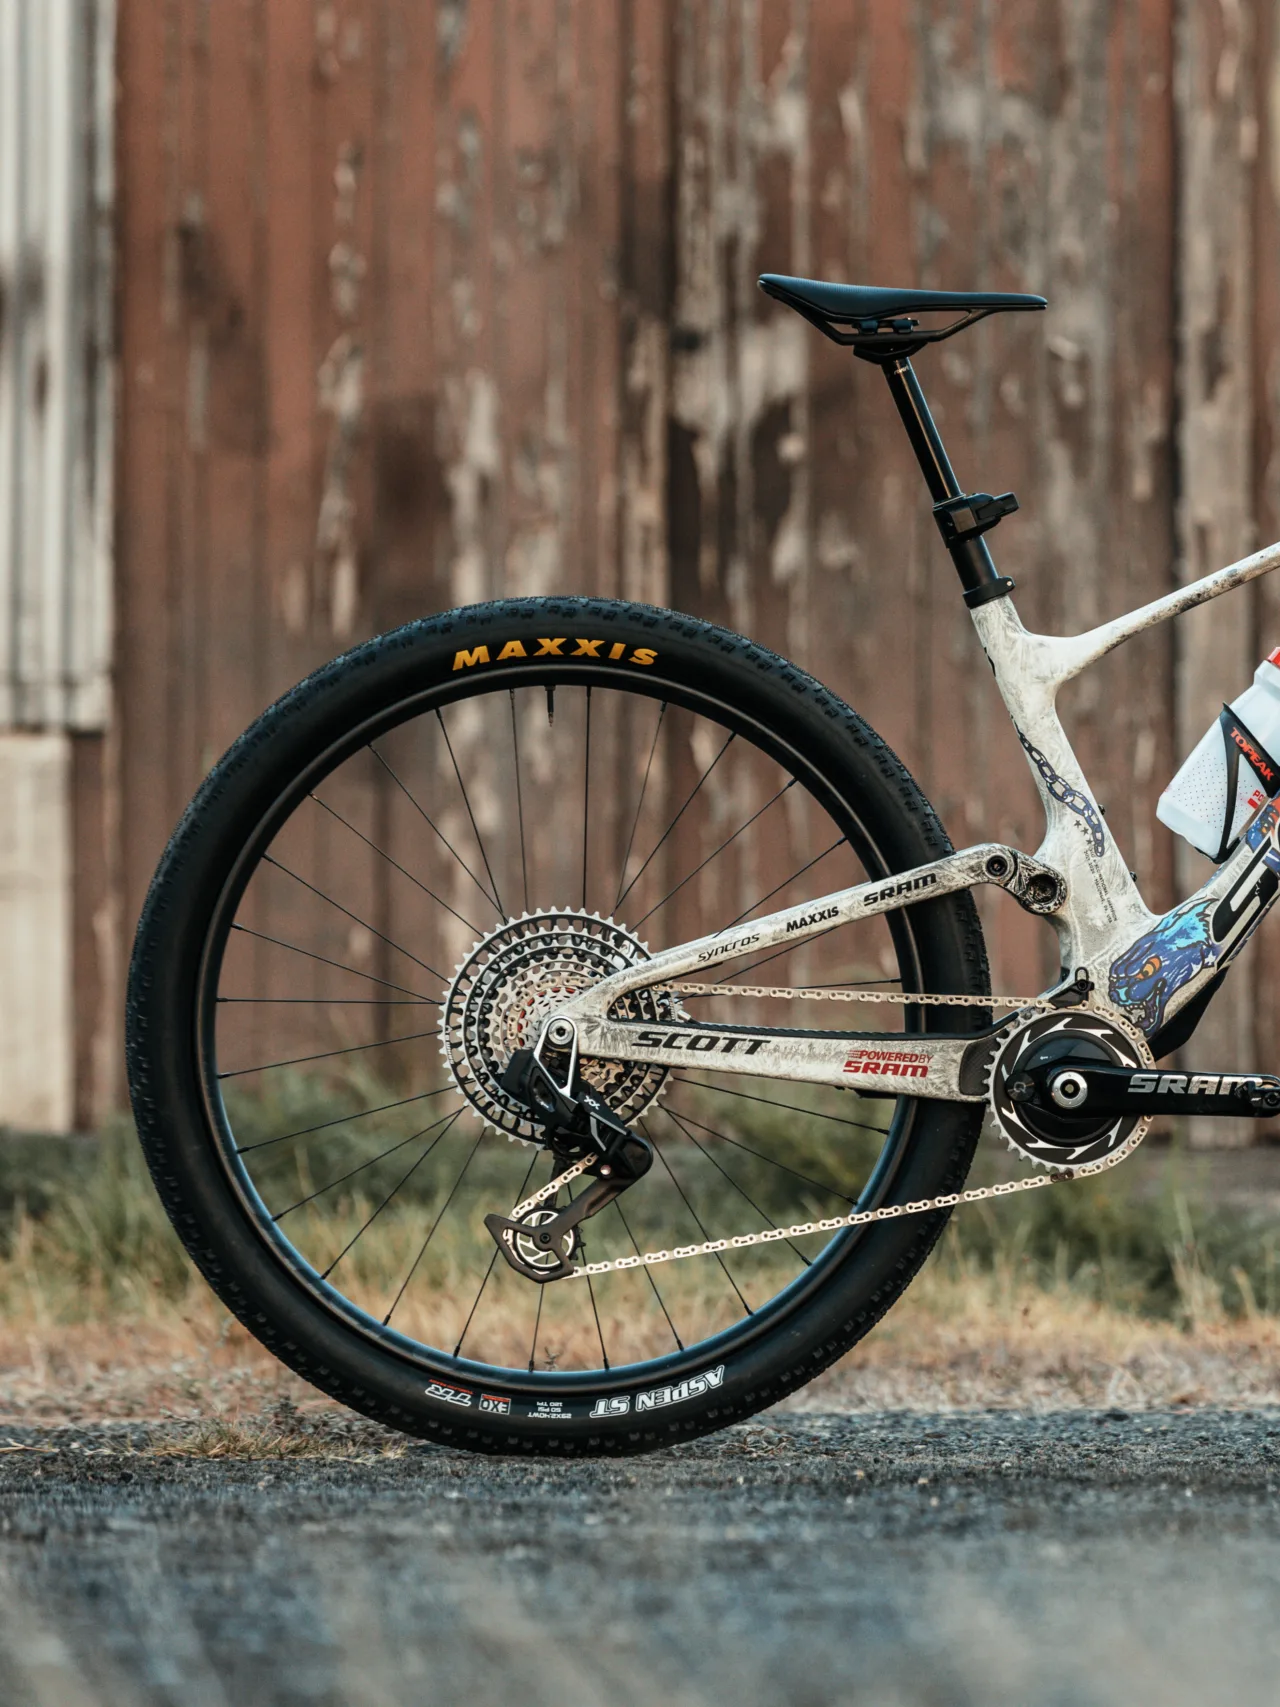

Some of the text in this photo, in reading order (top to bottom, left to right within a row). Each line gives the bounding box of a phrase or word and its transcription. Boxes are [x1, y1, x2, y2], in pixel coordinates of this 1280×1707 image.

[451, 637, 659, 671] MAXXIS
[1229, 727, 1276, 782] TOPEAK
[862, 873, 938, 907] SRAM
[785, 906, 840, 933] MAXXIS
[631, 1030, 772, 1055] SCOTT
[843, 1060, 929, 1078] SRAM
[1127, 1074, 1263, 1096] SRAM
[589, 1364, 726, 1418] ASPEN ST
[480, 1399, 510, 1414] EXO
